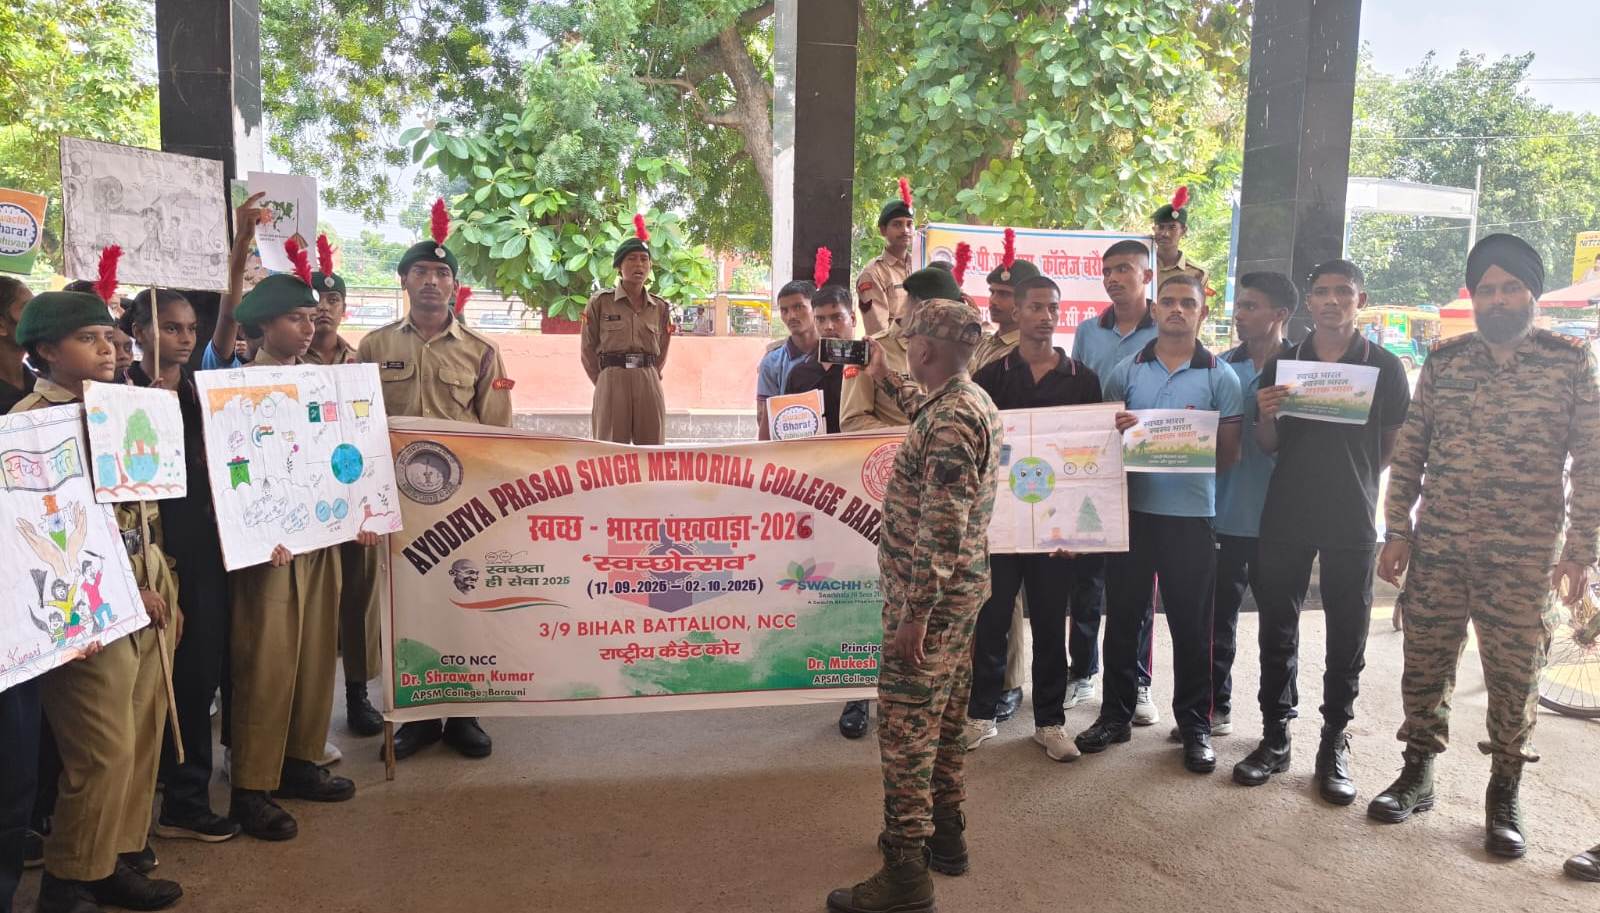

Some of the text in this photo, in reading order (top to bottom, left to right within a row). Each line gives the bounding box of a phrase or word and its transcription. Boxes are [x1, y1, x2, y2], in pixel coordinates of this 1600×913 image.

[0, 223, 28, 237] harat
[1042, 249, 1081, 276] कॉलेज
[1083, 250, 1102, 276] बरौ
[782, 420, 811, 432] Bharat
[402, 497, 497, 576] AYODHYA
[488, 464, 574, 518] PRASAD
[575, 453, 642, 491] SINGH
[647, 452, 755, 489] MEMORIAL
[759, 462, 848, 517] COLLEGE
[838, 495, 882, 546] BARA
[527, 515, 584, 541] स्वच्छ
[607, 517, 660, 541] भारत
[485, 564, 545, 574] स्वच्छता
[485, 575, 502, 587] ही
[507, 575, 540, 587] सेवा
[797, 580, 861, 591] SWACHH
[539, 614, 796, 640] 3/9 BIHAR BATTALION, NCC
[599, 643, 655, 664] राष्ट्रीय
[704, 639, 741, 655] कोर
[841, 643, 882, 653] Princip
[440, 655, 497, 666] CTO NCC
[807, 656, 877, 670] Dr. Mukesh
[401, 670, 535, 686] Dr. Shrawan Kumar
[813, 675, 840, 684] APSM
[412, 689, 442, 700] APSM
